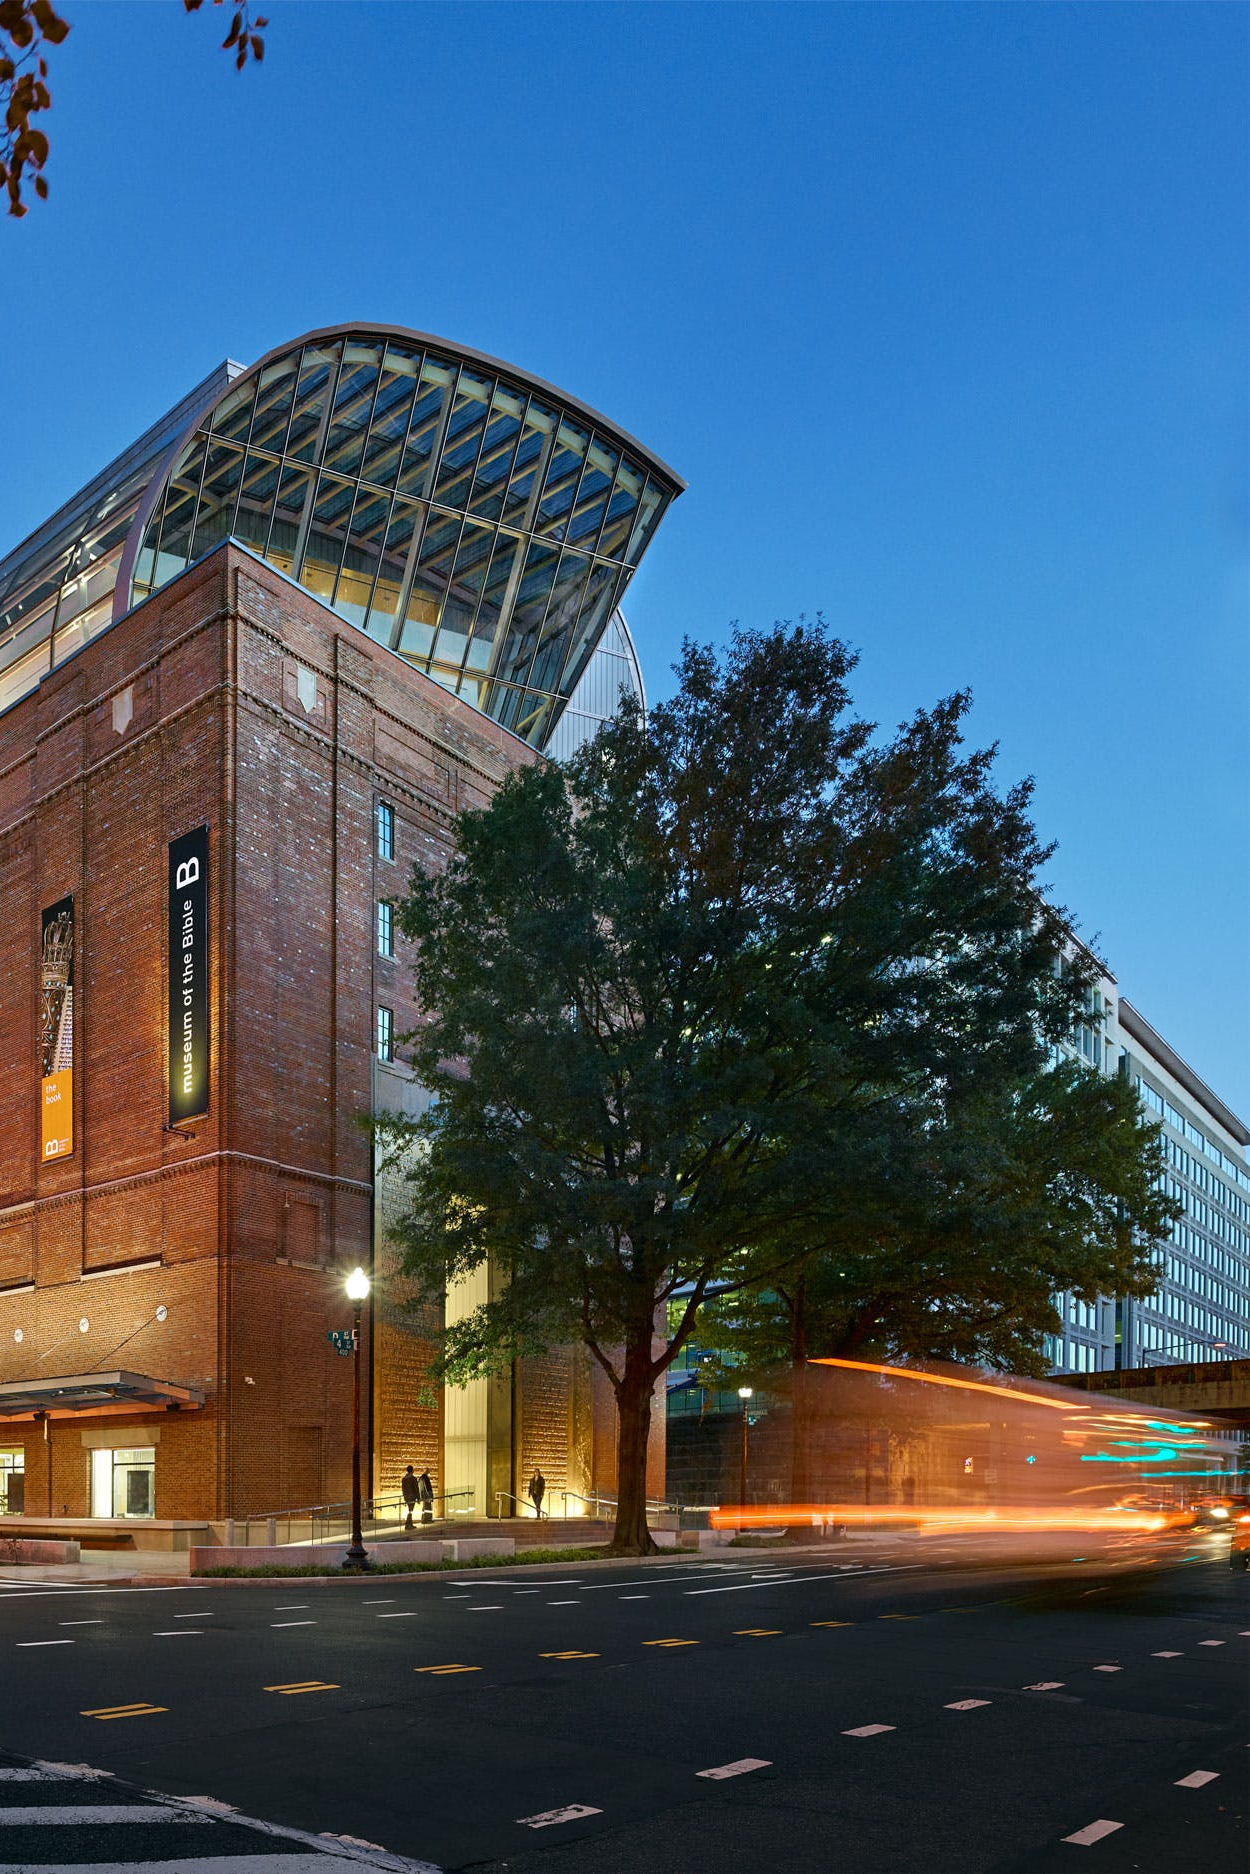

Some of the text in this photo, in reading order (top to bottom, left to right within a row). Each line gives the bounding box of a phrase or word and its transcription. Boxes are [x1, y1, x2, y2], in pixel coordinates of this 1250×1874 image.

[176, 856, 199, 1094] museum of the Bible B
[46, 1084, 56, 1093] the
[46, 1092, 61, 1105] book
